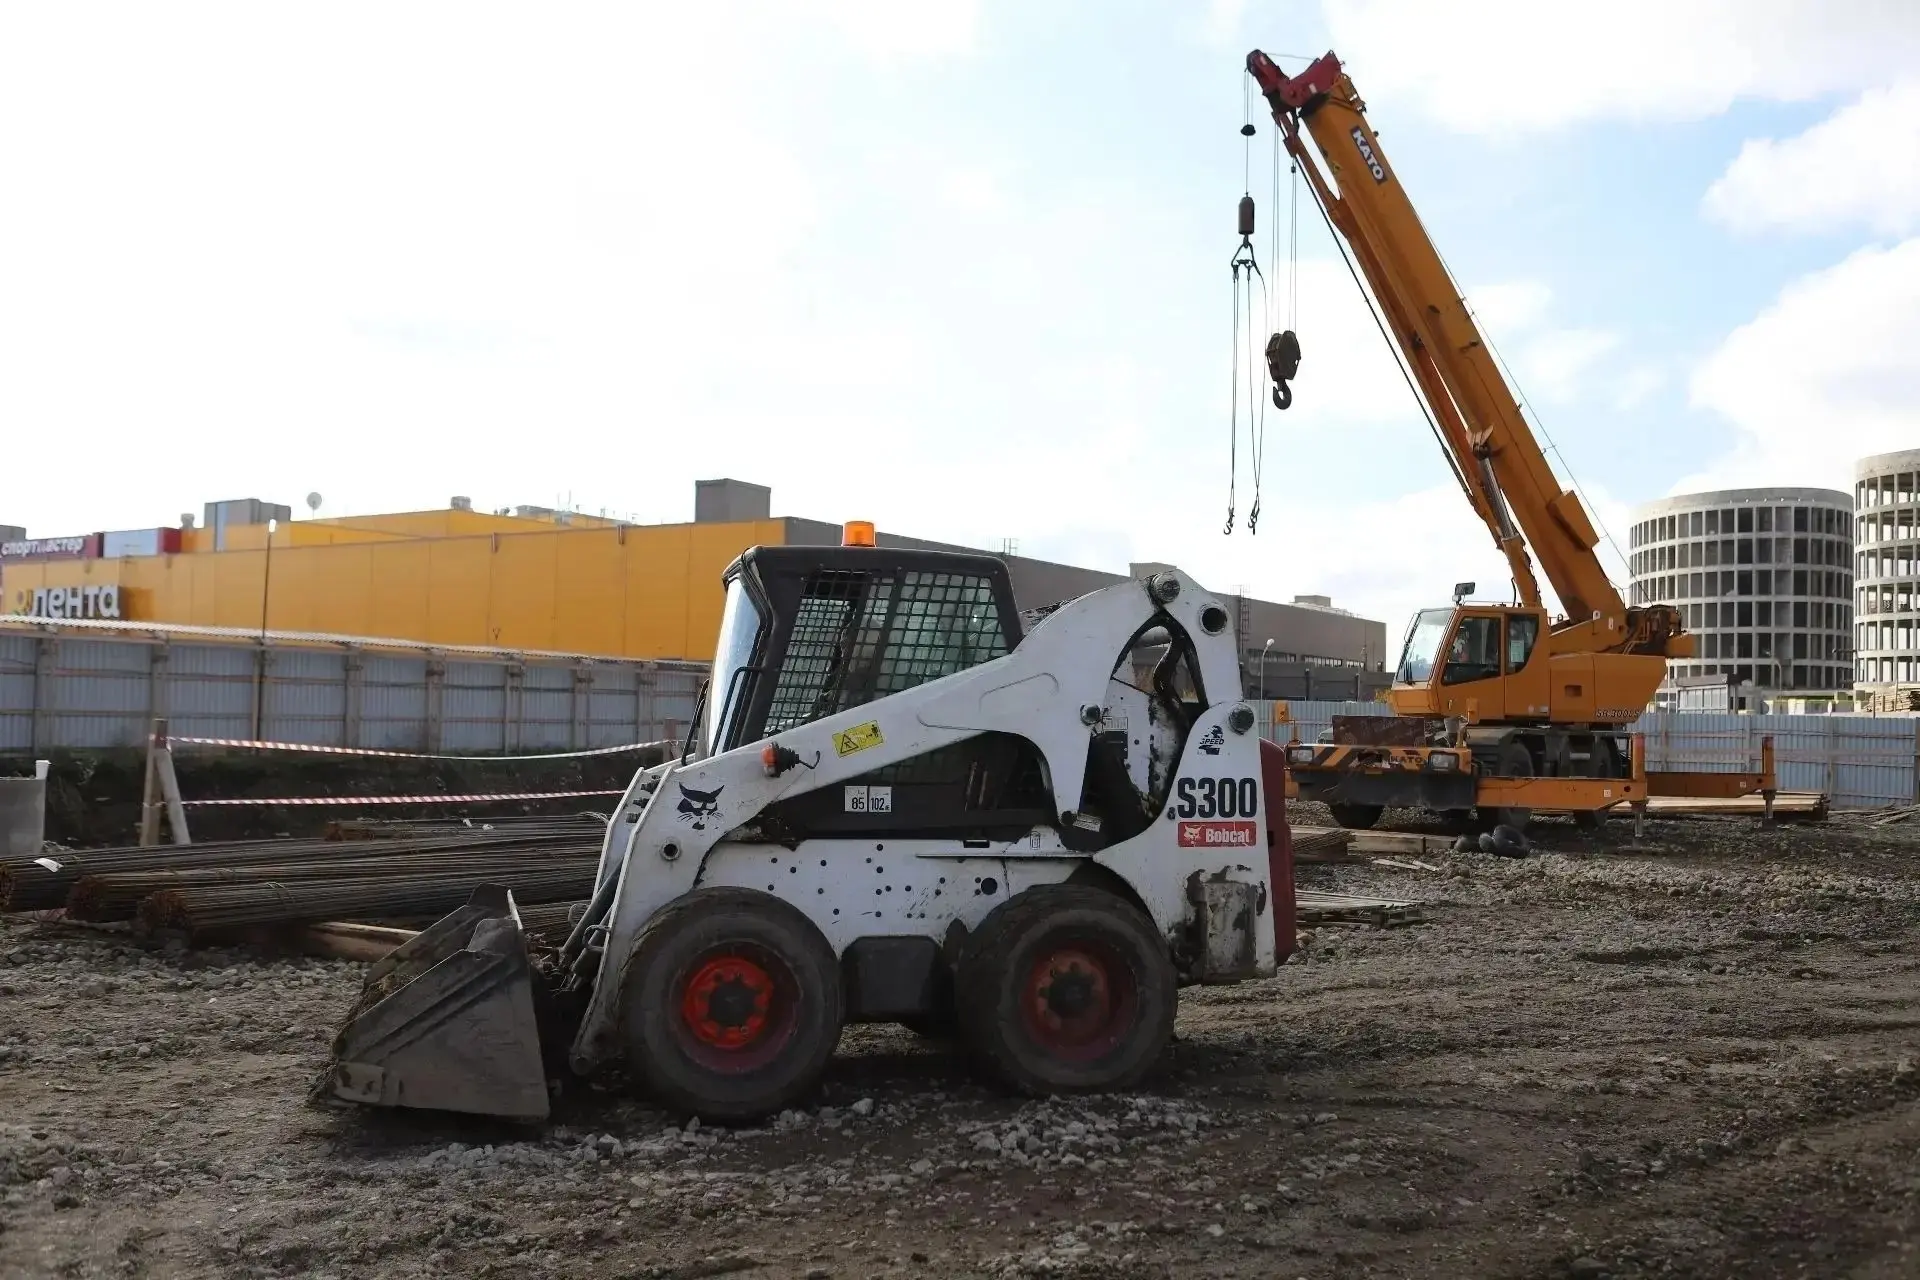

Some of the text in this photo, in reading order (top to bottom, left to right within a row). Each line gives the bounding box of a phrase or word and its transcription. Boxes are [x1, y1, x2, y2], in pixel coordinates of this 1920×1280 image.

[1353, 130, 1384, 180] KATO
[29, 584, 120, 618] лента
[851, 797, 865, 810] 85
[870, 797, 885, 811] 102
[1177, 777, 1257, 818] S300
[1205, 828, 1250, 843] Bobcat
